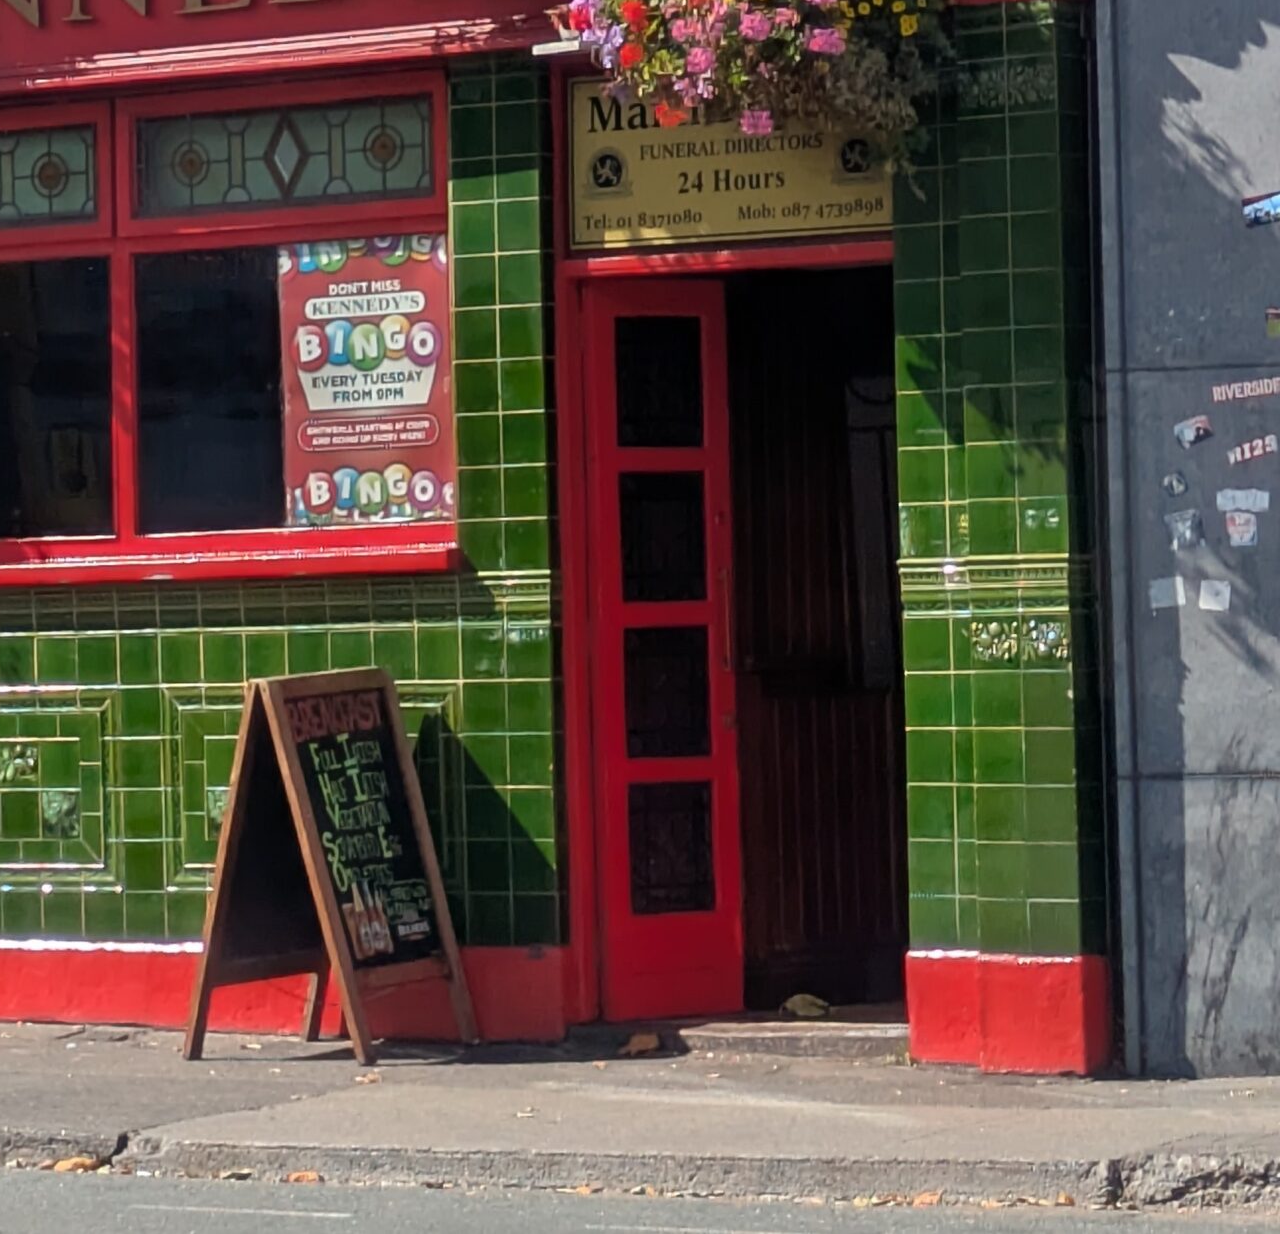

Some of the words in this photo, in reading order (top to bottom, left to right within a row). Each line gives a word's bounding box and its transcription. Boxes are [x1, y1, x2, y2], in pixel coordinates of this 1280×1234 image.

[640, 140, 720, 162] FUNERAL
[724, 133, 824, 156] DIRECTORS
[678, 171, 703, 194] 24
[713, 168, 785, 192] Hours
[584, 215, 612, 231] Tel:
[737, 204, 776, 221] Mob:
[329, 281, 368, 295] DON'T
[371, 279, 401, 293] MISS
[312, 295, 419, 316] KENNEDY'S
[295, 321, 437, 365] BINGO
[312, 373, 357, 389] EVERY
[362, 370, 423, 386] TUESDAY
[333, 389, 372, 403] FROM
[308, 471, 435, 508] BINGO
